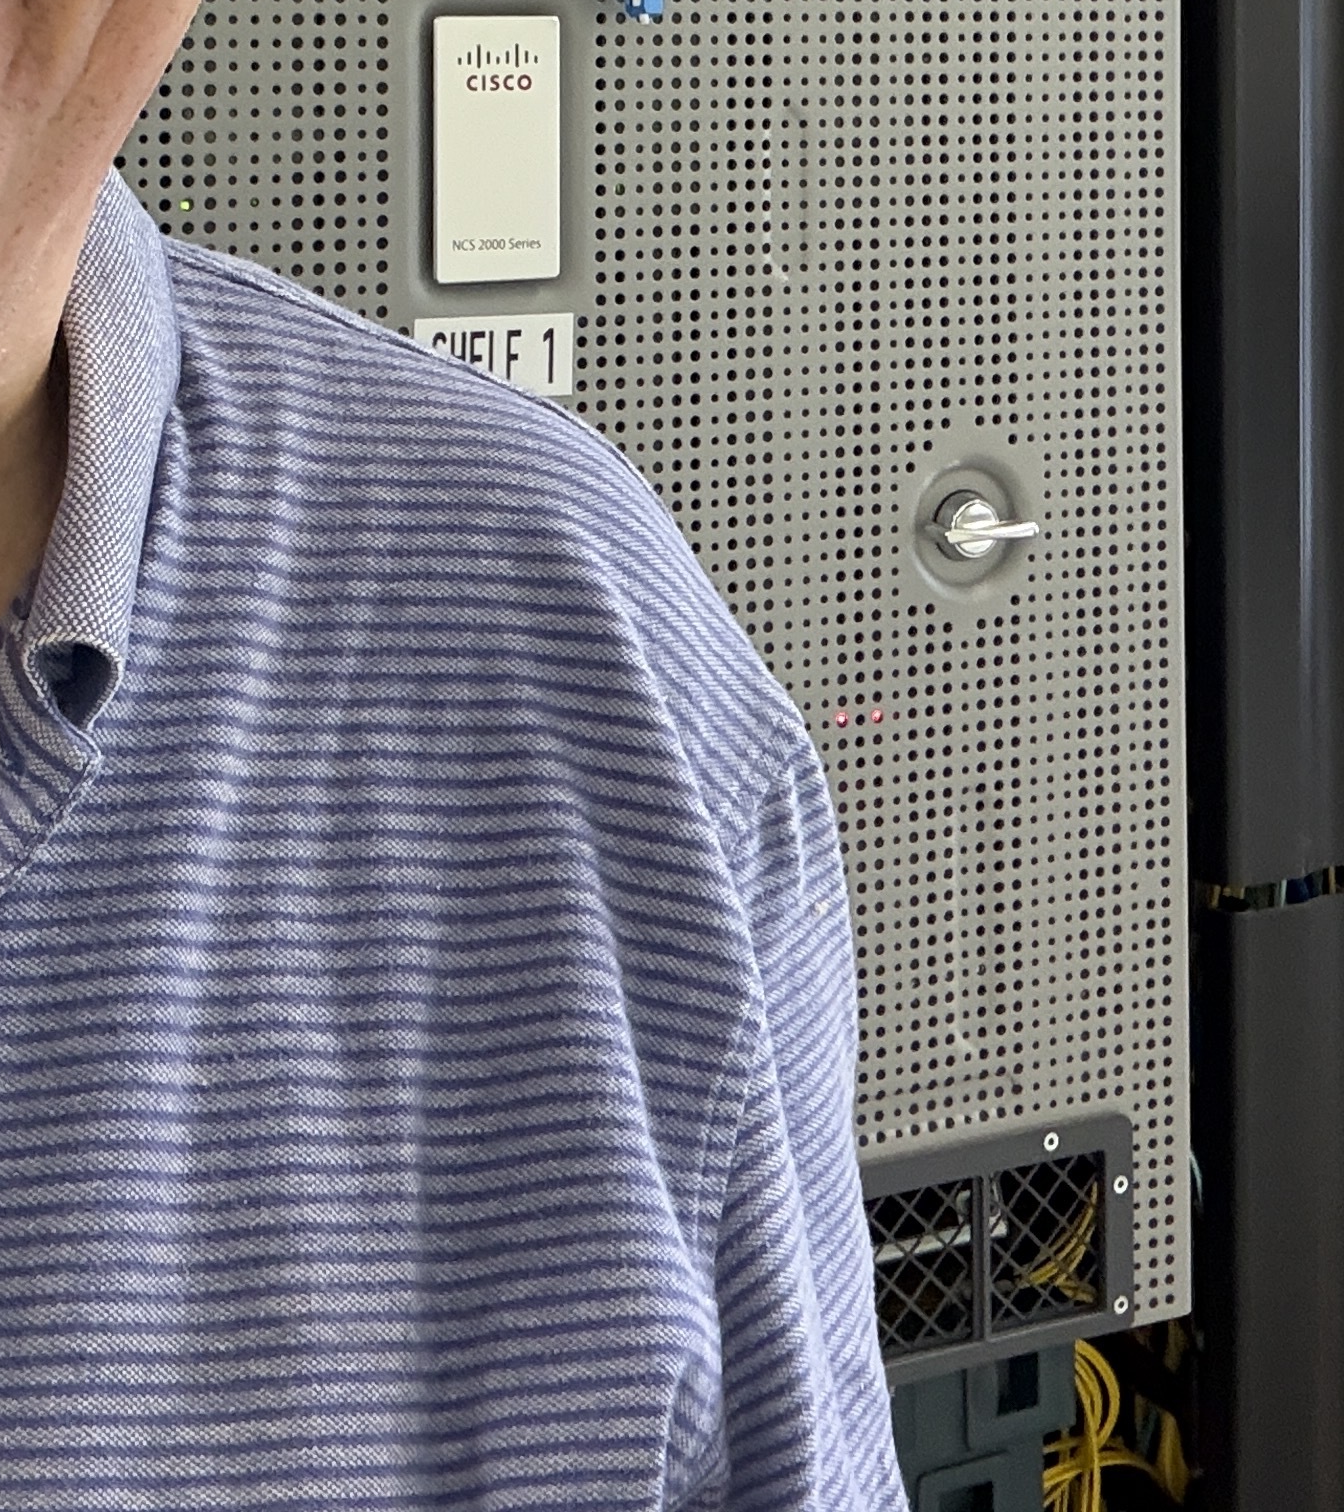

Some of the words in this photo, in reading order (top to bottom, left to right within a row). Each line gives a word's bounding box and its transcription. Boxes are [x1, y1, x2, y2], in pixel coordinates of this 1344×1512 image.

[466, 74, 532, 92] CISCO
[452, 238, 476, 252] NCS
[478, 237, 506, 251] 2000
[508, 237, 542, 250] Series
[543, 327, 554, 384] 1
